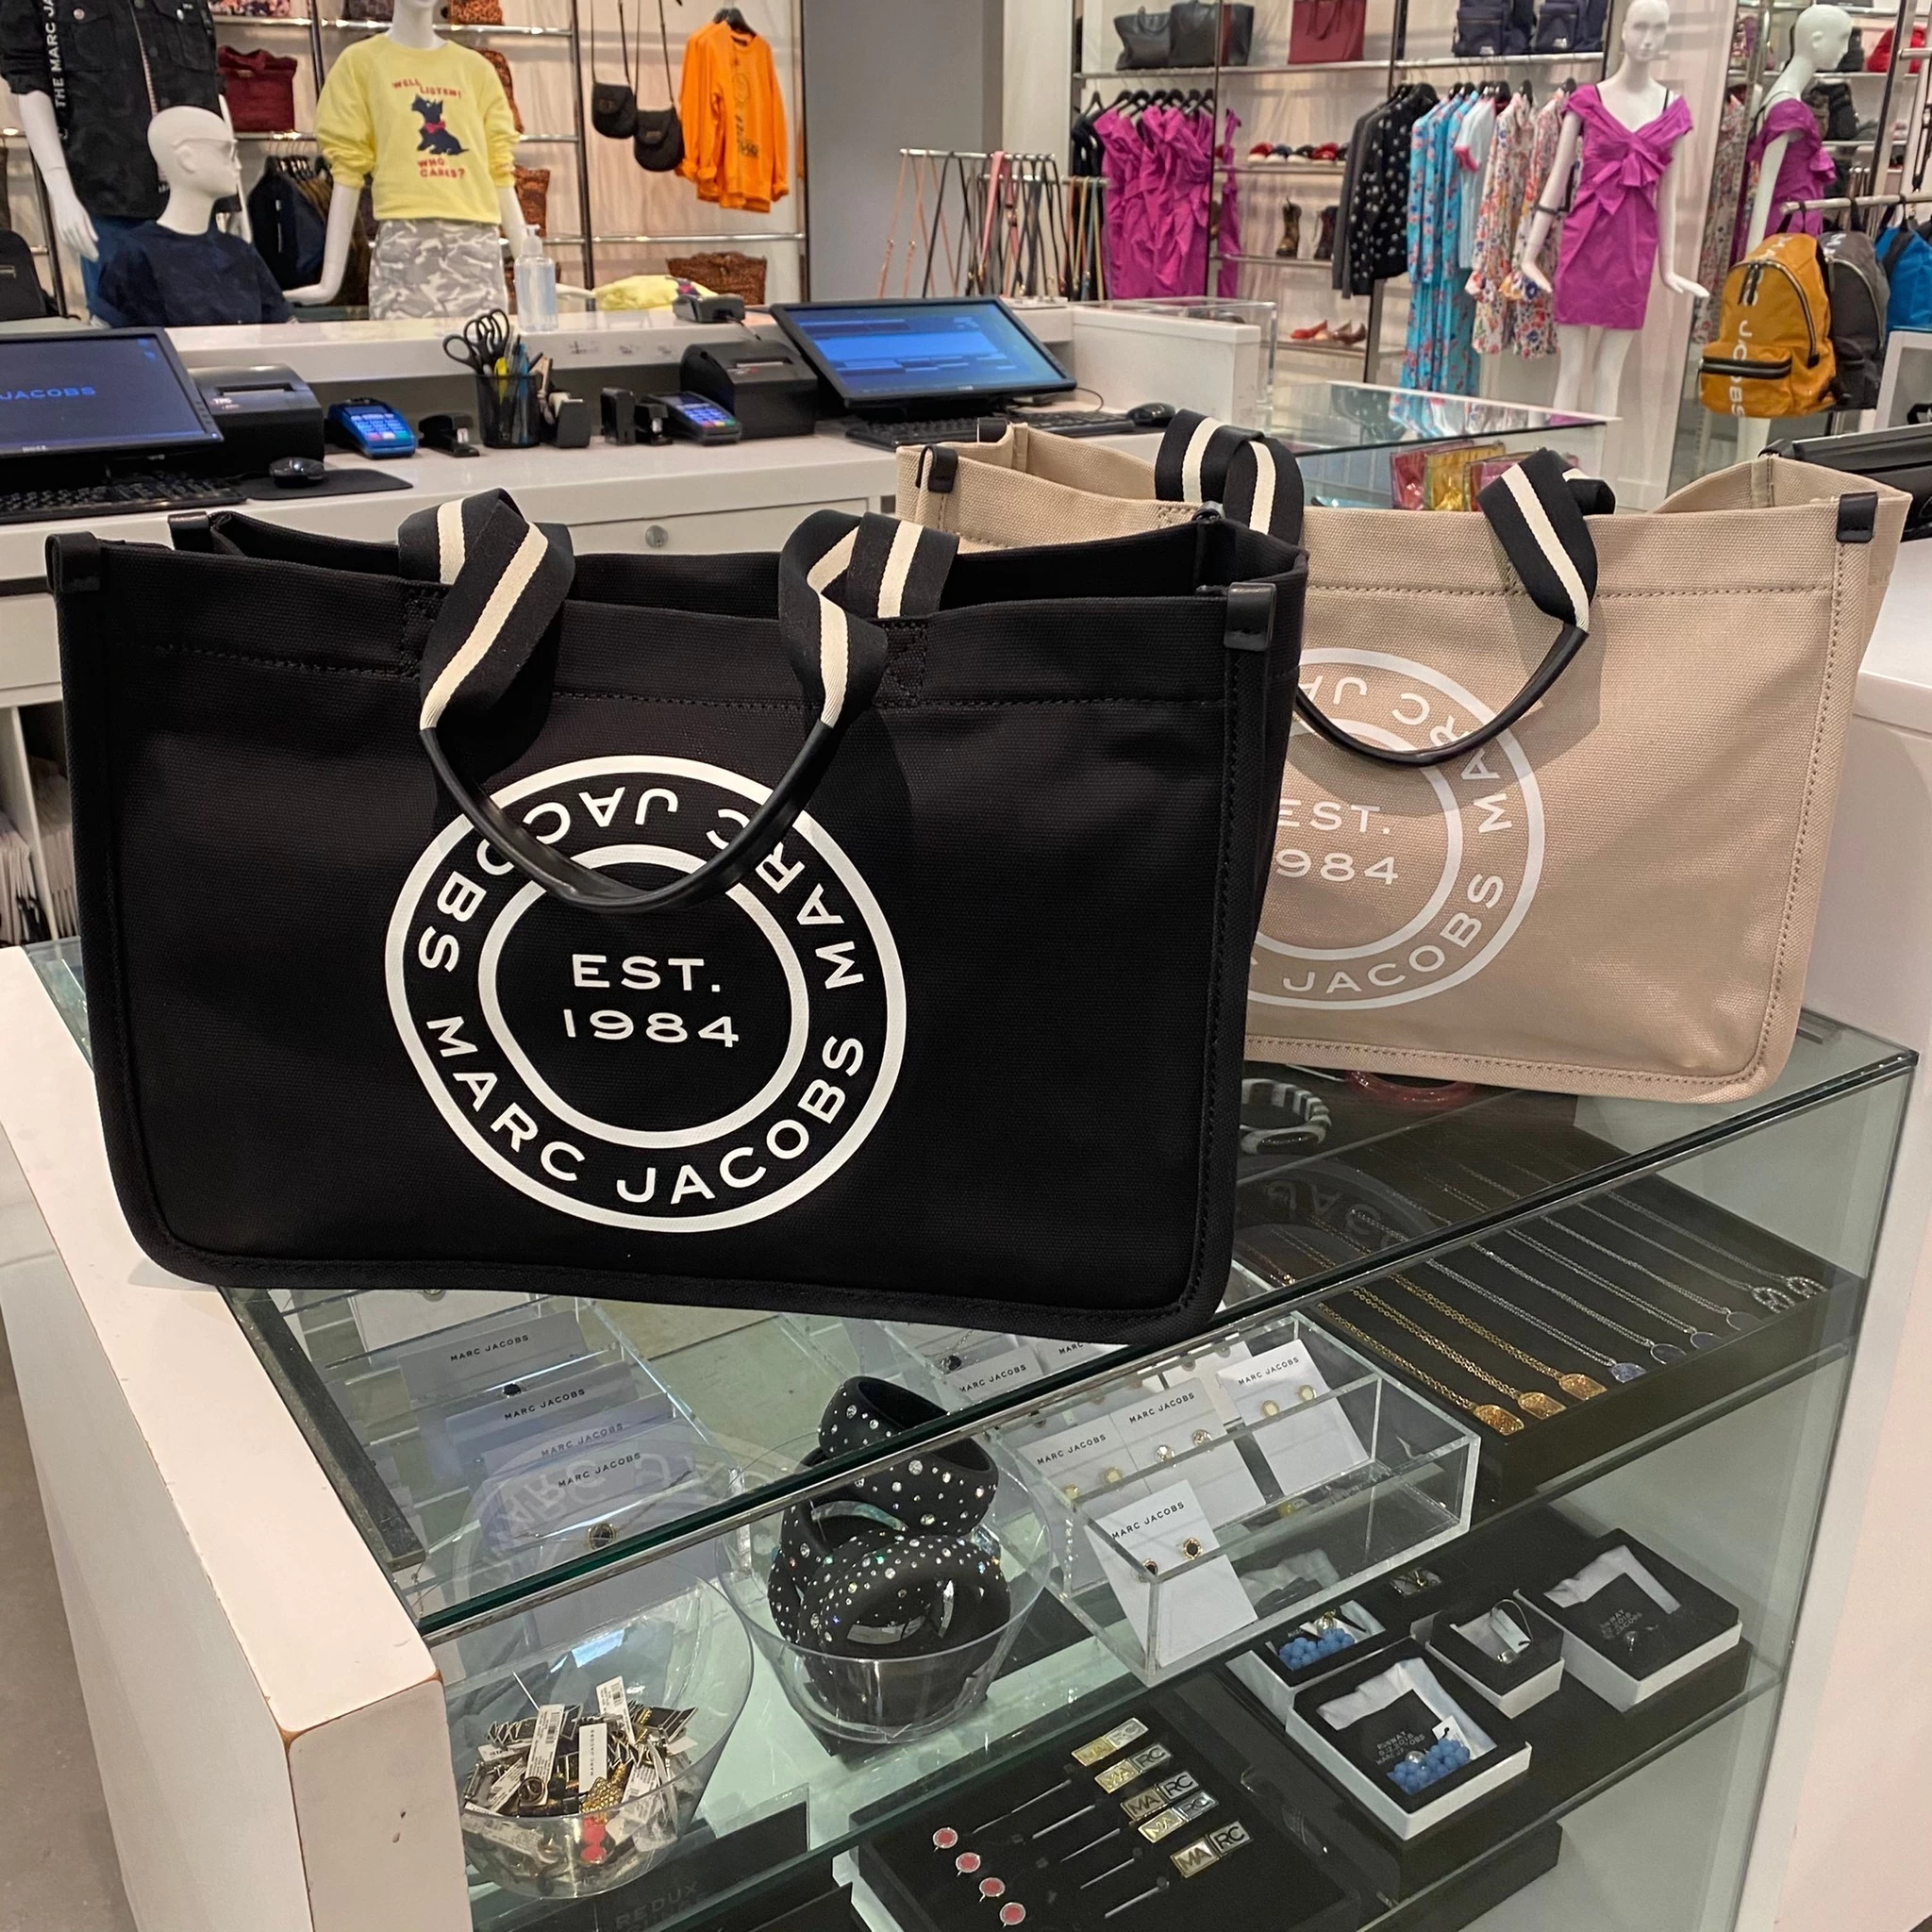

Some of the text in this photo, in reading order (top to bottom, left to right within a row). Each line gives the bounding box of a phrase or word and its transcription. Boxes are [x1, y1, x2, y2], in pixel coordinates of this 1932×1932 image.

[45, 22, 62, 72] MARC
[52, 77, 67, 108] THE
[417, 157, 444, 168] WHO
[1274, 849, 1399, 885] 984
[1282, 873, 1505, 994] JACOBS
[573, 954, 721, 992] EST.
[563, 1008, 739, 1048] 1984
[426, 1016, 864, 1204] MARC JACOBS
[450, 1335, 529, 1361] MARC JACOBS
[990, 1364, 1026, 1383] JACOBS
[1238, 1357, 1299, 1385] MARC JACOBS
[505, 1389, 586, 1421] MARC JACOBS
[1129, 1392, 1195, 1424] MARC JACOBS
[541, 1423, 623, 1457] MARC JACOBS
[1037, 1434, 1107, 1465] MARC JACOBS
[558, 1453, 641, 1488] MARC JACOBS
[1112, 1502, 1185, 1539] MARC JACOBS
